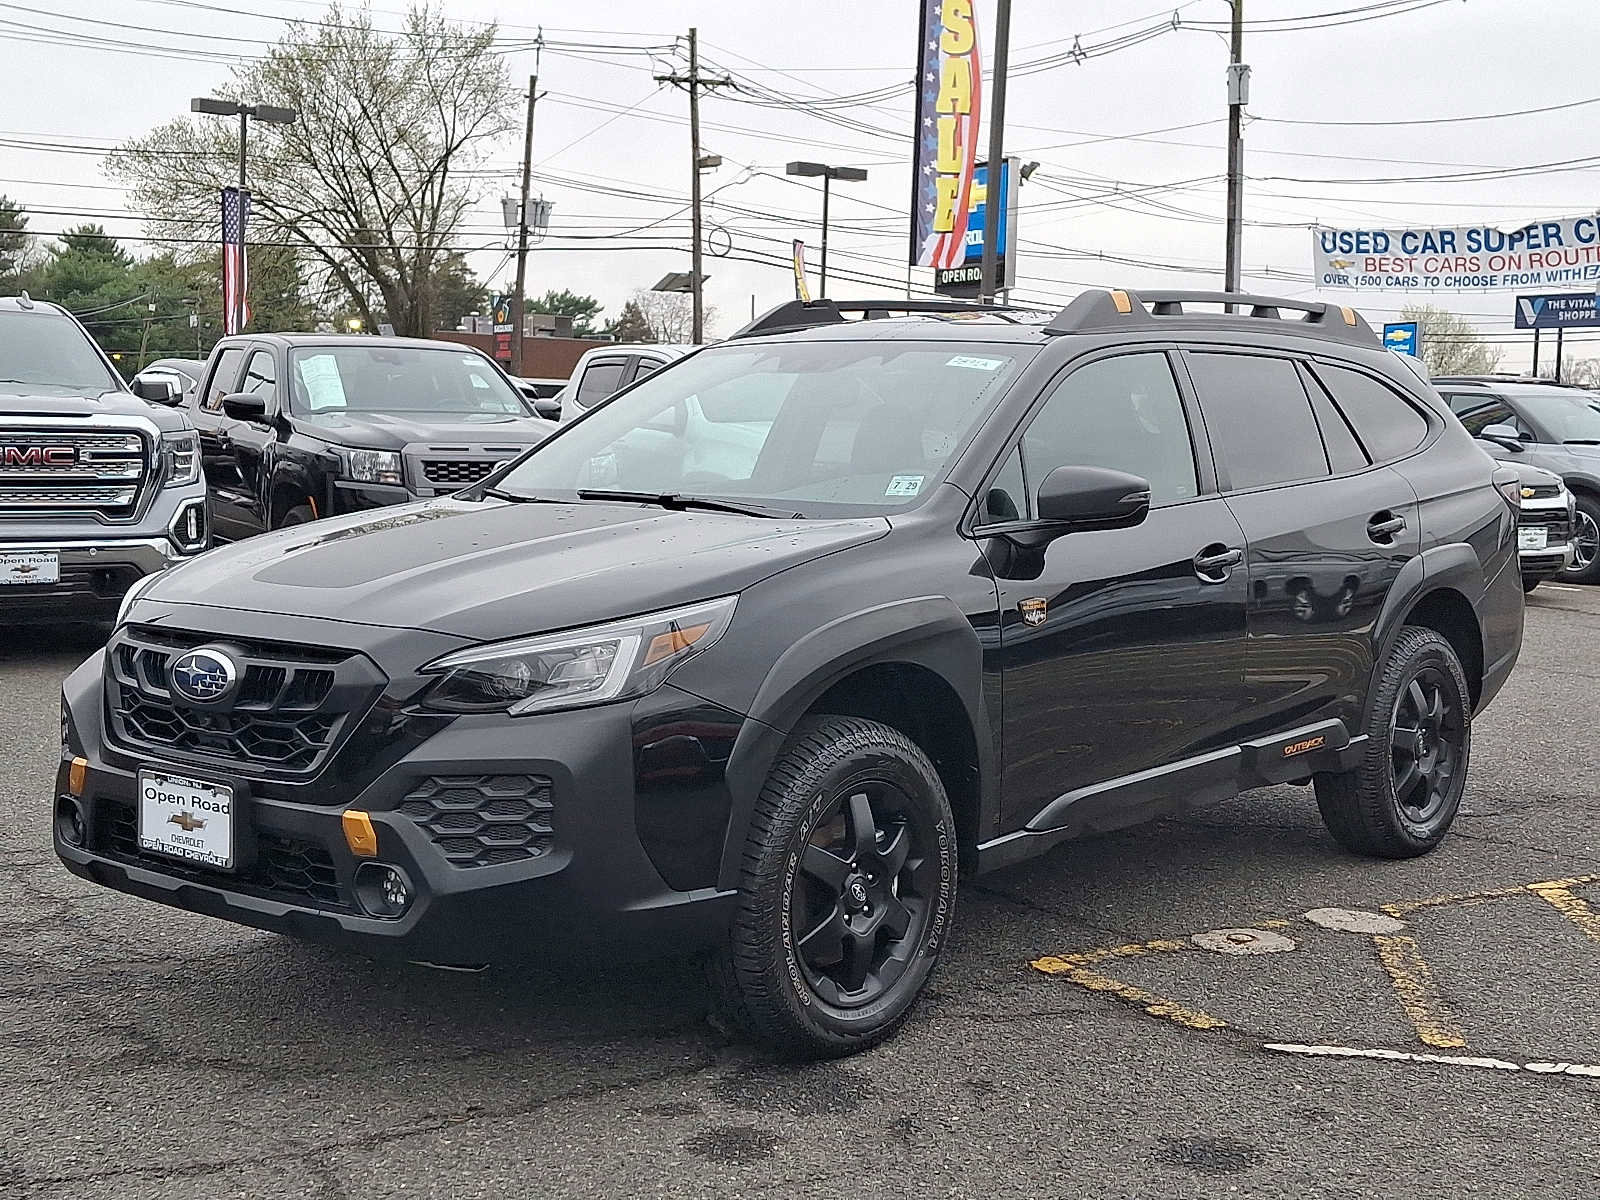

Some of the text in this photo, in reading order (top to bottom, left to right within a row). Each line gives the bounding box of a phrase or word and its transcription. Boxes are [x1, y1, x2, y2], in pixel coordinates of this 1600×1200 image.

[932, 0, 975, 232] SALE
[1321, 218, 1600, 255] USED CAR SUPER C
[1365, 257, 1418, 272] BEST
[1424, 256, 1480, 273] CARS
[1488, 255, 1521, 271] ON
[942, 269, 966, 283] OPEN
[1323, 273, 1349, 285] OVER
[1354, 275, 1381, 286] 1500
[1385, 276, 1418, 287] CARS
[1424, 276, 1440, 287] TO
[1444, 275, 1498, 287] CHOOSE
[1502, 272, 1541, 285] FROM
[1546, 268, 1581, 283] WITH
[1548, 300, 1566, 309] THE
[1558, 310, 1597, 321] SHOPPE
[0, 447, 75, 466] MC
[893, 481, 918, 490] 7 29
[1284, 736, 1324, 754] OUTBACK
[145, 787, 230, 814] Open Road
[171, 834, 204, 849] CHEVROLET
[143, 839, 226, 867] OPEN ROAD CHEVROLET
[928, 819, 951, 949] YOKOHAMA
